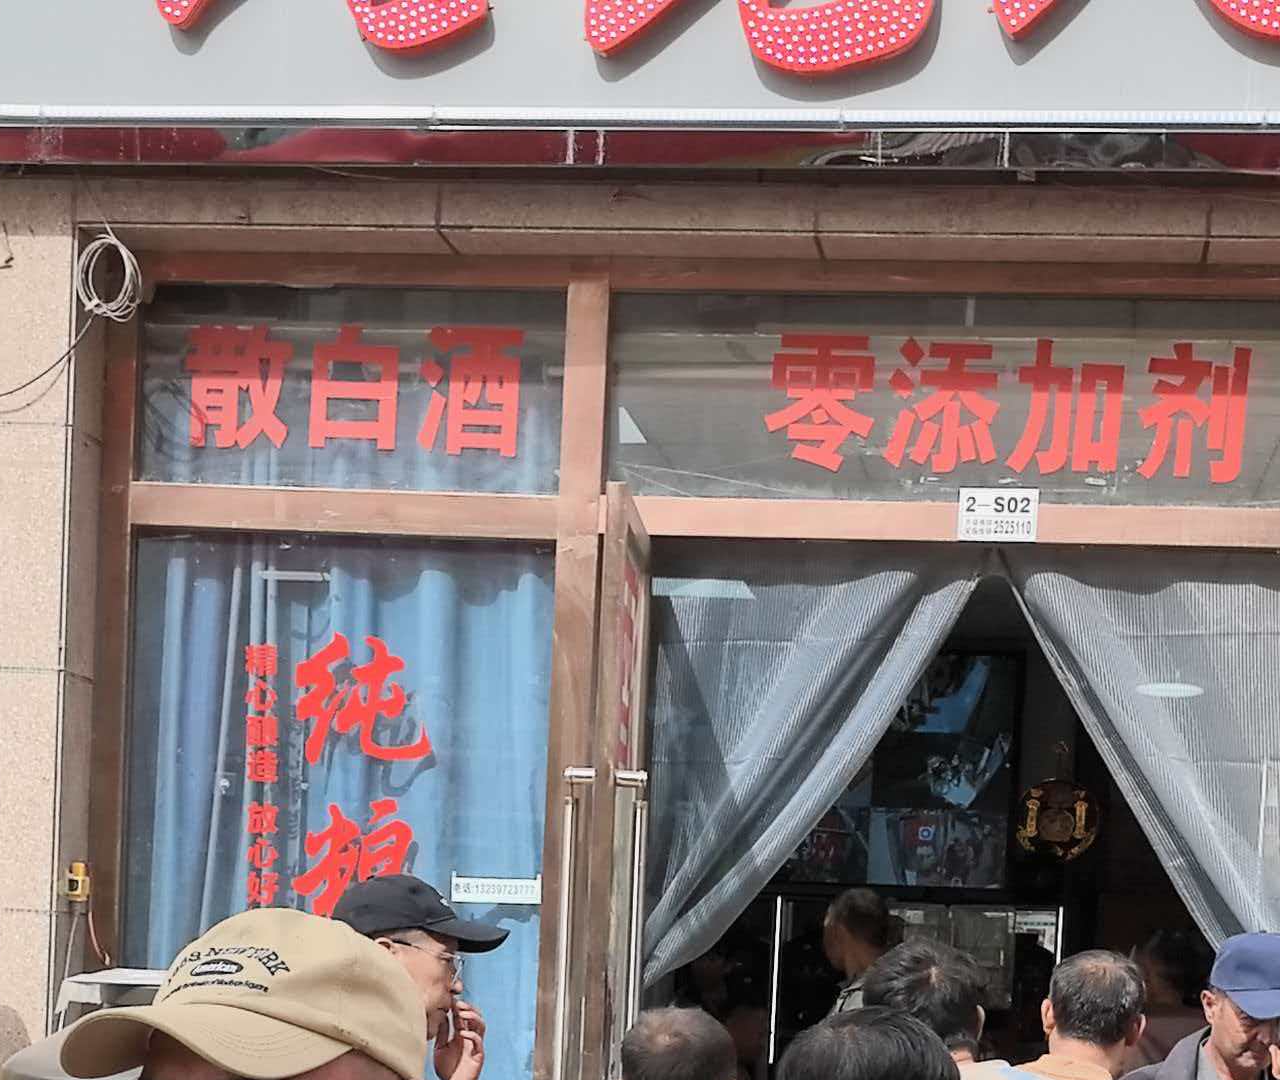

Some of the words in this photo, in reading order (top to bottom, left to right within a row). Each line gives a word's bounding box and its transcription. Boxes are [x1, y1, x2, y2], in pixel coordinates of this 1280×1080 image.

[185, 323, 525, 457] 散白酒
[764, 333, 1252, 484] 零添加剂
[966, 496, 1031, 513] 2-S02
[245, 643, 279, 783] 精心酿造
[291, 632, 432, 918] 纯粮
